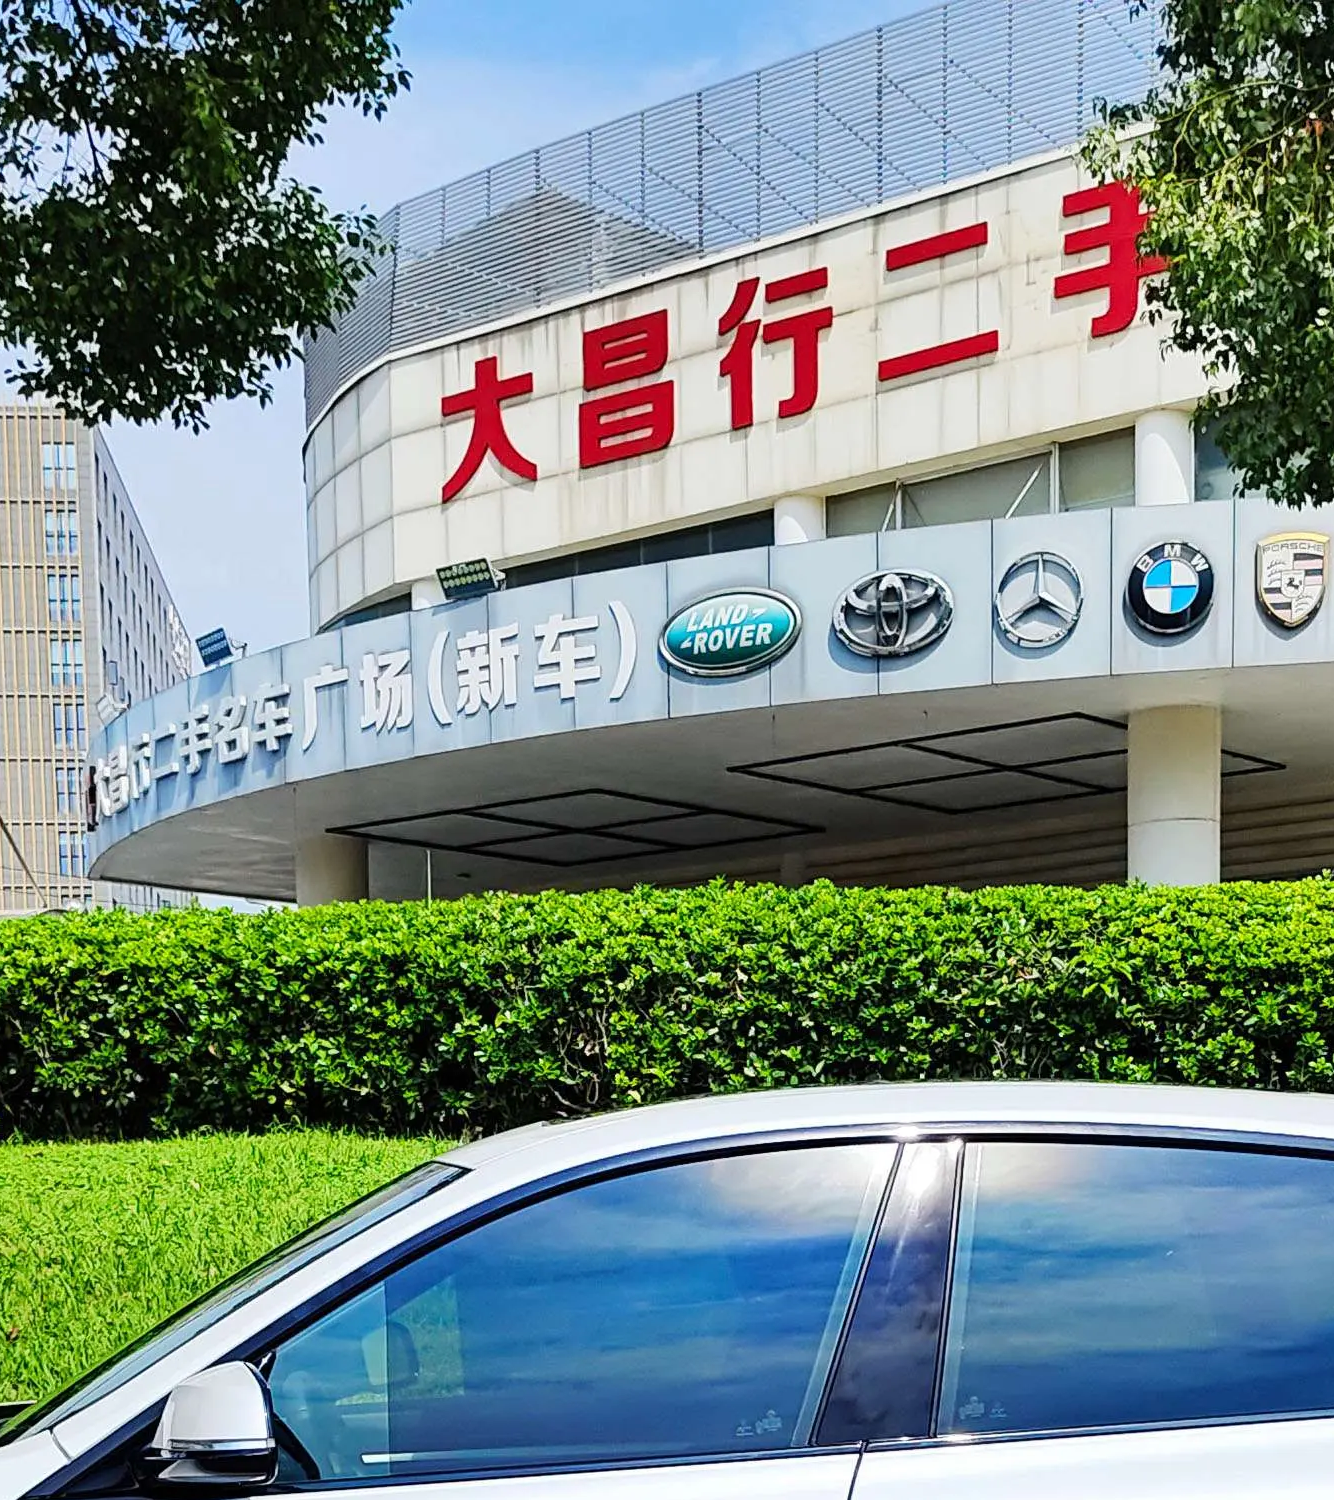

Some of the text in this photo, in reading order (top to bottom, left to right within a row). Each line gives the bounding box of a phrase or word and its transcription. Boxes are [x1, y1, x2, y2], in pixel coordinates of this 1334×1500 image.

[1136, 543, 1209, 573] BMW
[1262, 542, 1324, 554] PORSCHE
[687, 603, 749, 632] LAND
[693, 622, 773, 655] ROVER
